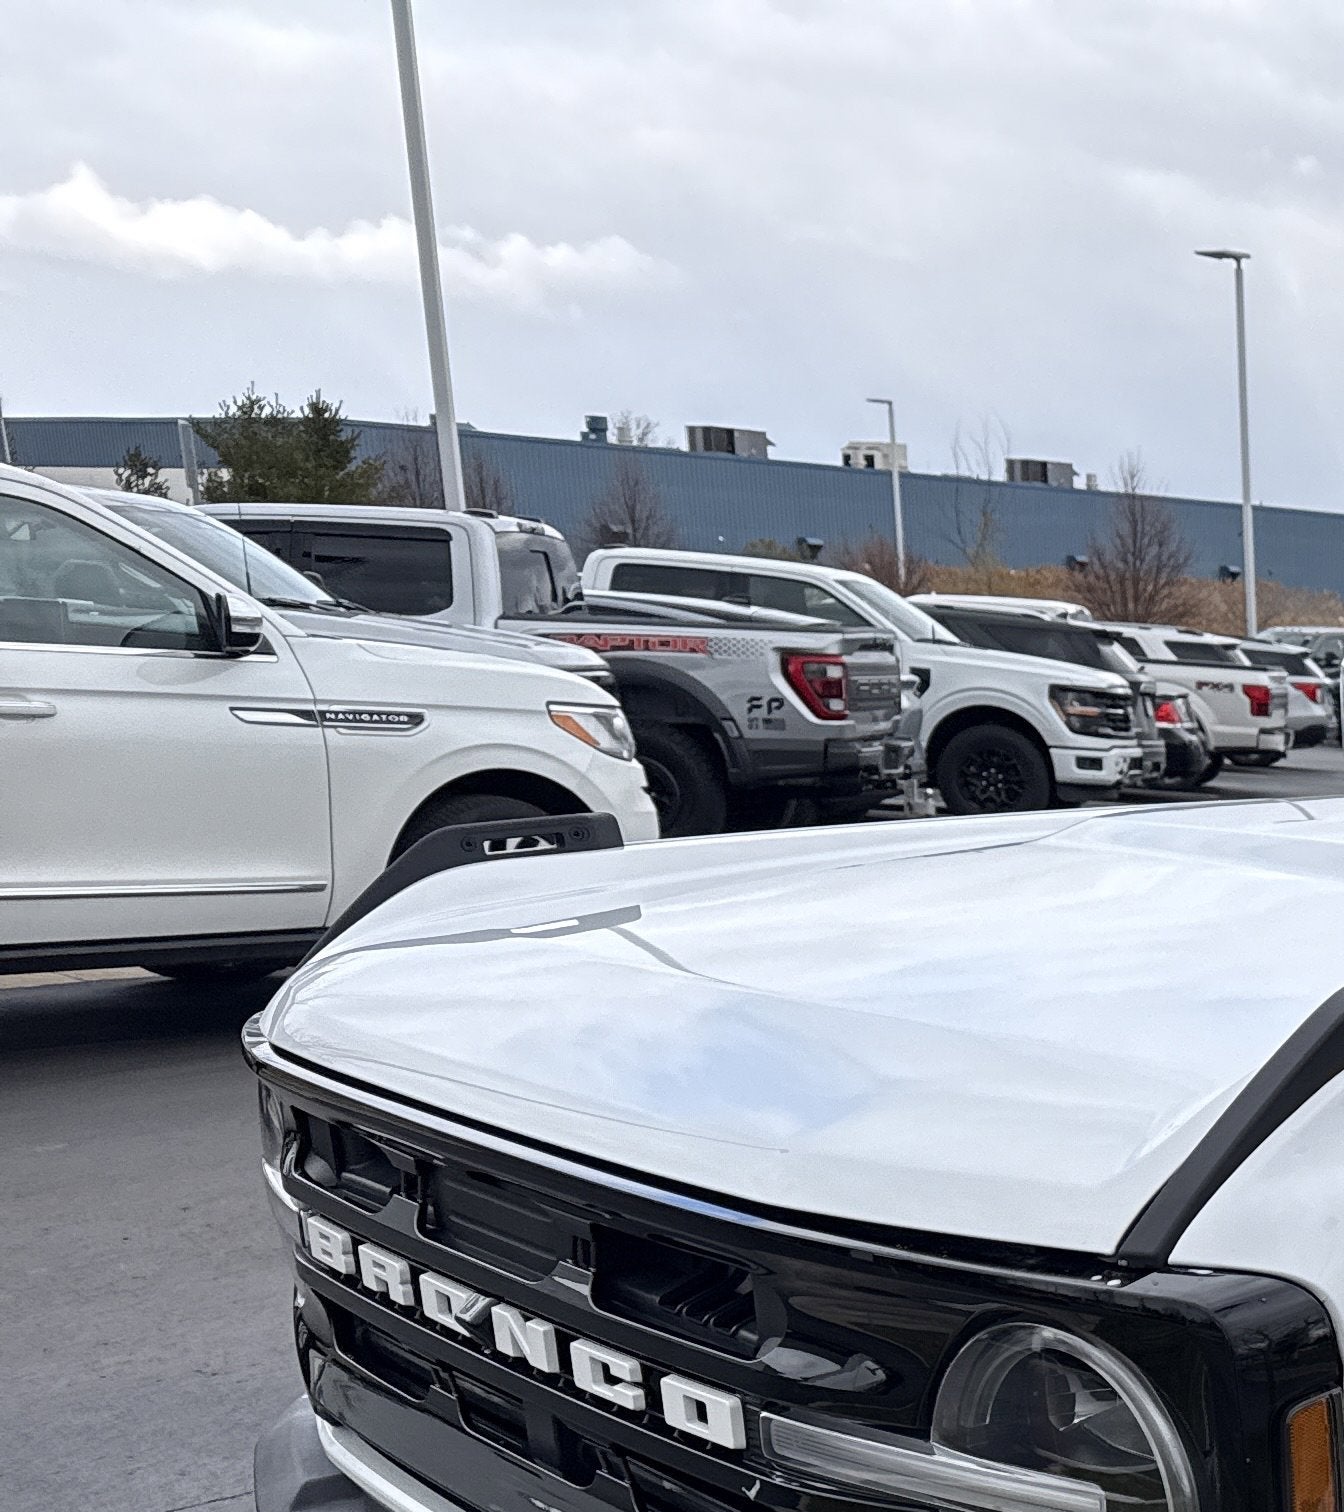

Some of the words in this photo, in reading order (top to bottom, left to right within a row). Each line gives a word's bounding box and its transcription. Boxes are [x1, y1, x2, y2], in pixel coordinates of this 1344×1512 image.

[746, 695, 785, 716] FP
[325, 712, 409, 722] NAVIGATOR
[306, 1213, 748, 1451] BRONCO
